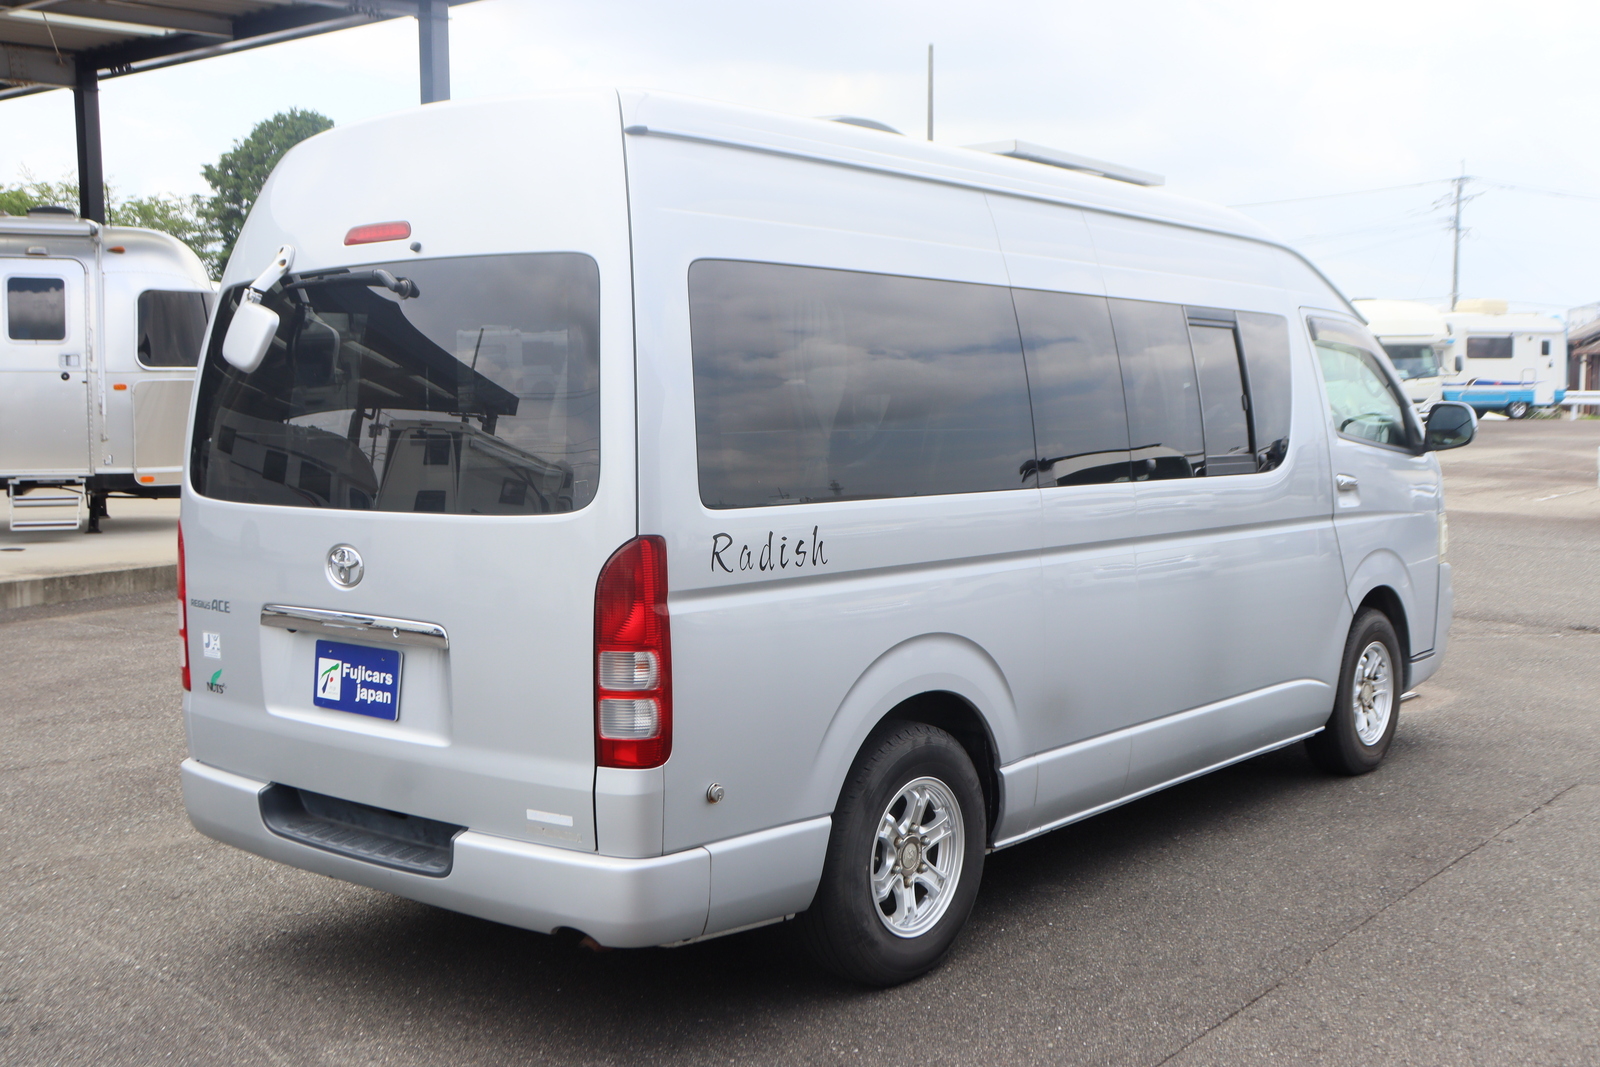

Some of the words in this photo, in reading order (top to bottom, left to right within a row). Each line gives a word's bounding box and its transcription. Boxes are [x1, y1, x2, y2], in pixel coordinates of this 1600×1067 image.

[711, 525, 828, 573] Radish
[211, 599, 230, 613] ACE
[342, 663, 393, 685] Fujicars
[355, 683, 392, 704] japan
